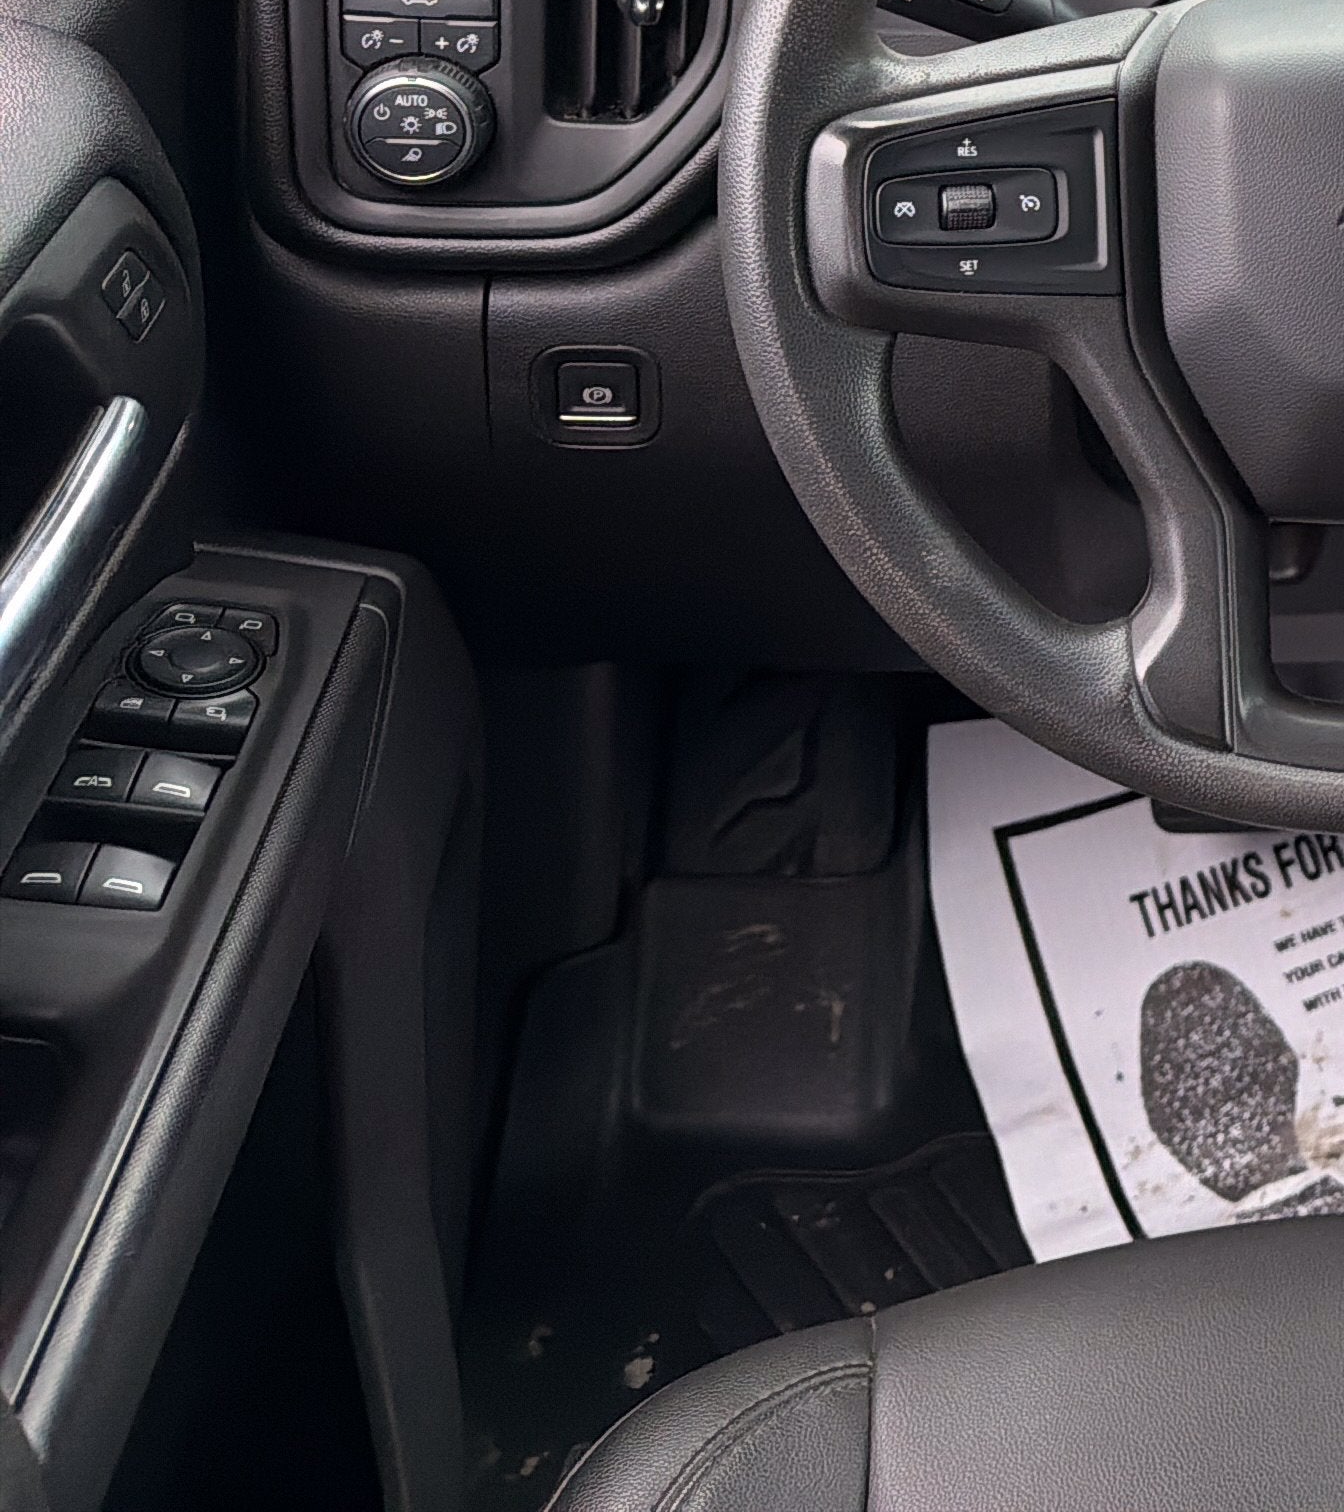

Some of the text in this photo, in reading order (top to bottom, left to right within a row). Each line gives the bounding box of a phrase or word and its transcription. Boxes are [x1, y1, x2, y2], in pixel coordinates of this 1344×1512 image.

[395, 94, 428, 108] AUTO
[957, 146, 978, 157] RES
[959, 259, 978, 271] SET
[1129, 851, 1273, 938] THANKS
[1274, 933, 1297, 952] WE
[1301, 919, 1337, 943] HAVE
[1283, 958, 1325, 983] YOUR
[1302, 987, 1343, 1012] WITH
